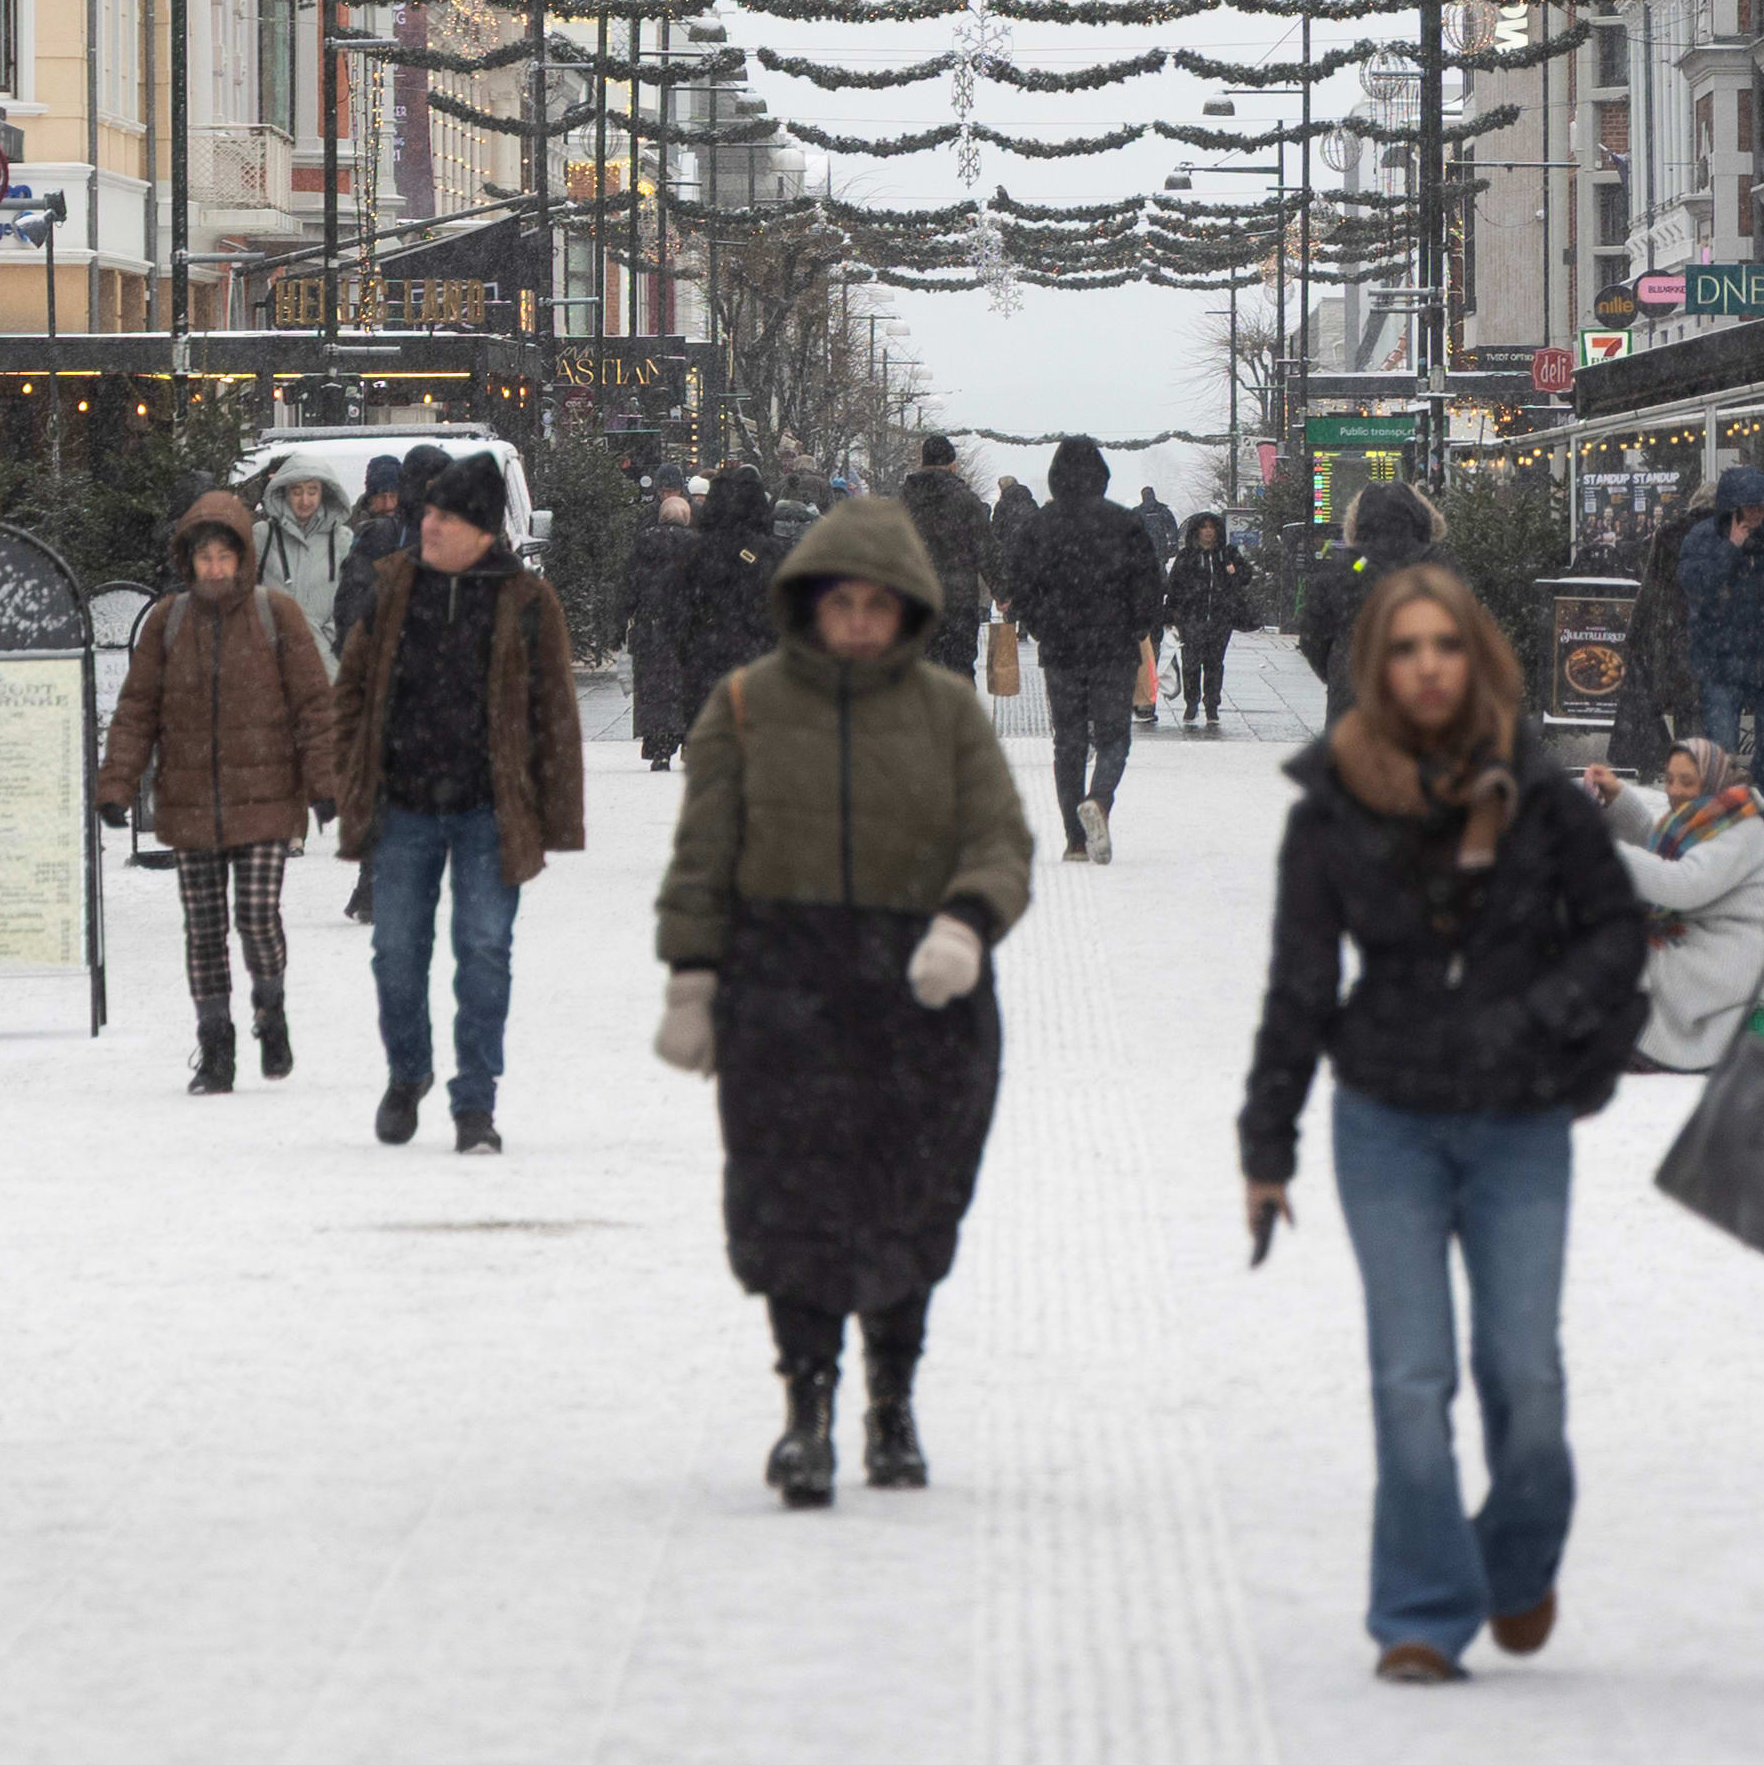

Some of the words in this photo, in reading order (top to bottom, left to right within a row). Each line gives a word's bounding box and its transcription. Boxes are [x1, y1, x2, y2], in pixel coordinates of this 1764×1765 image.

[1597, 296, 1635, 314] nille
[1540, 355, 1567, 383] deli
[1339, 426, 1369, 437] Public
[1583, 473, 1630, 486] STANDUP
[1632, 471, 1680, 485] STANDUP
